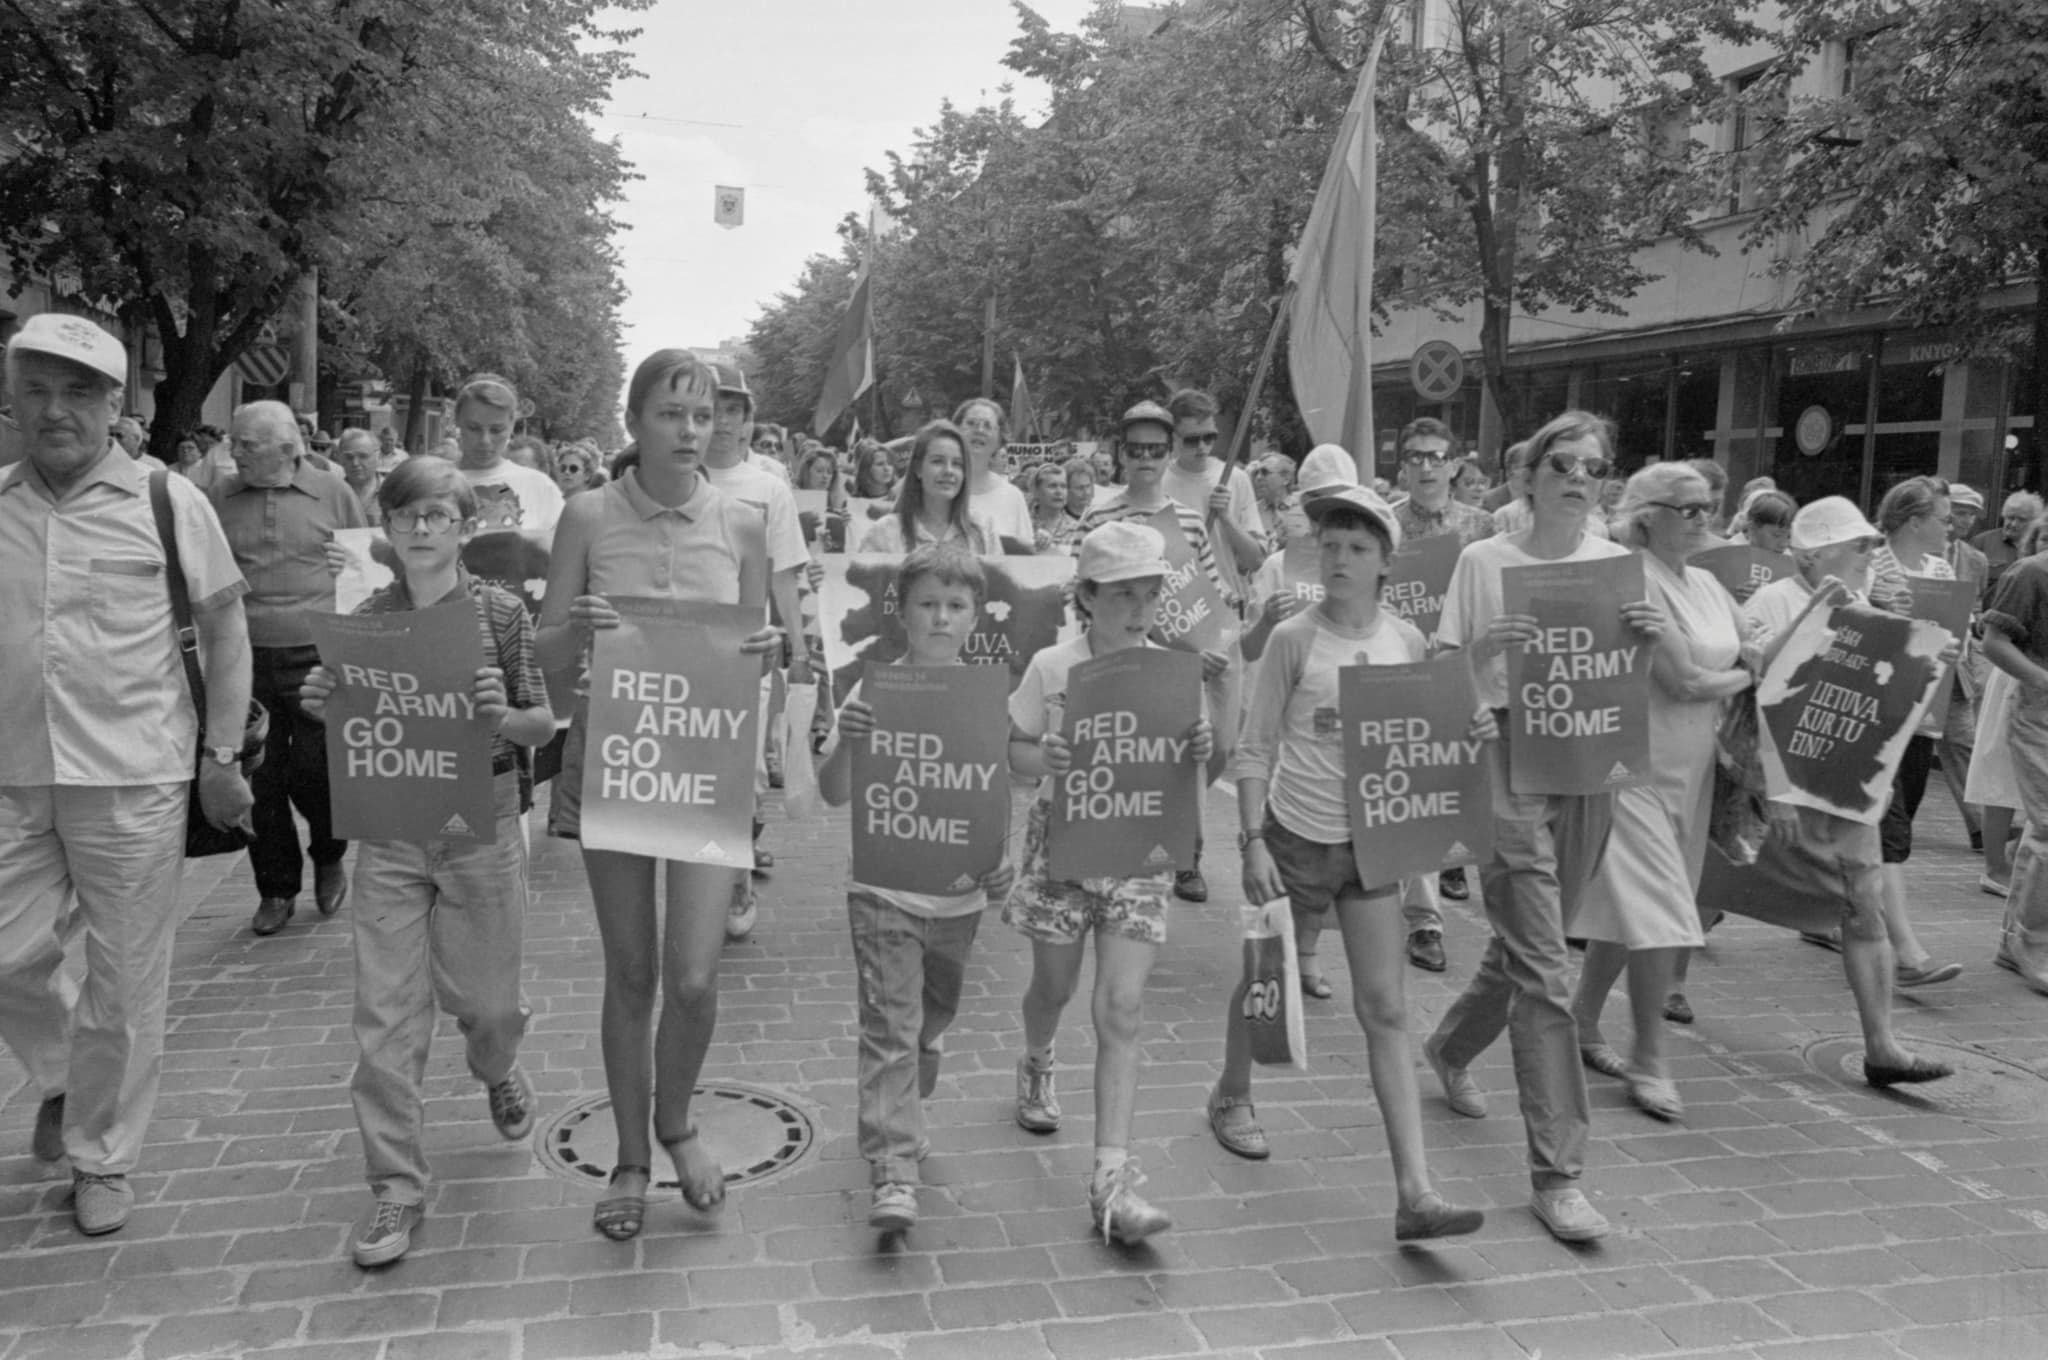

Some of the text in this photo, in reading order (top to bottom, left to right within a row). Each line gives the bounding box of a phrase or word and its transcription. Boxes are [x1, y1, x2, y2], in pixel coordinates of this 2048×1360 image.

[1160, 558, 1198, 602] ARMY
[1750, 563, 1772, 581] ED
[1295, 582, 1327, 602] RE
[1380, 580, 1426, 605] RED
[1399, 594, 1447, 617] ARM
[1154, 599, 1182, 626] GO
[1161, 597, 1211, 642] HOME
[1523, 627, 1594, 654] RED
[342, 663, 419, 694] RED
[1548, 645, 1638, 681] ARMY
[611, 668, 690, 704] RED
[1522, 683, 1573, 710] GO
[375, 692, 475, 720] ARMY
[1809, 680, 1881, 725] LIETUVA,
[343, 717, 404, 747] GO
[635, 704, 748, 740] ARMY
[1074, 711, 1138, 745] RED
[1360, 717, 1430, 746] RED
[1525, 706, 1621, 738] HOME
[1797, 705, 1866, 743] KUR TU
[601, 734, 661, 768] GO
[871, 729, 943, 760] RED
[1091, 737, 1189, 765] ARMY
[1385, 740, 1482, 770] ARMY
[1787, 730, 1835, 760] EINI?
[348, 749, 458, 780] HOME
[894, 760, 998, 791] ARMY
[602, 767, 717, 805] HOME
[1065, 766, 1115, 796] GO
[1359, 770, 1410, 800] GO
[865, 783, 919, 812] GO
[1066, 791, 1163, 822] HOME
[1364, 791, 1460, 828] HOME
[868, 809, 970, 845] HOME
